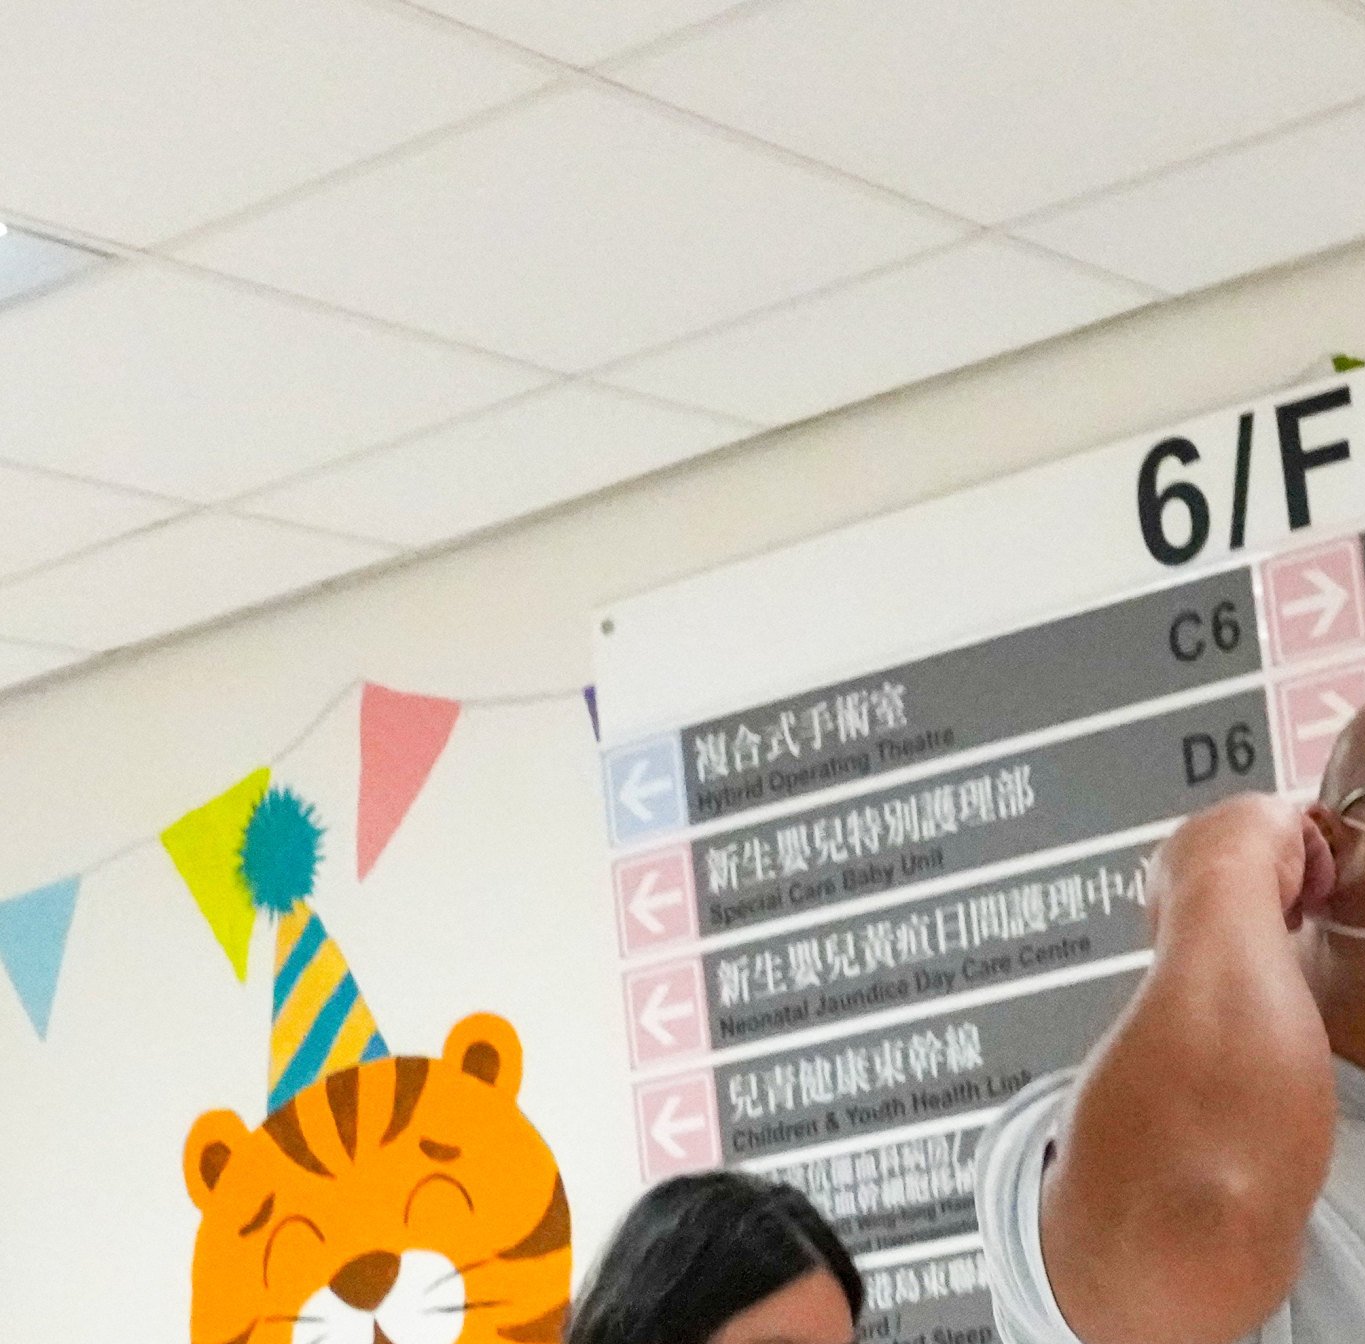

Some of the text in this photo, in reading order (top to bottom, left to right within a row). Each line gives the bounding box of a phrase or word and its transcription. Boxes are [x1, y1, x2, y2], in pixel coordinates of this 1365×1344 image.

[1137, 385, 1352, 566] 6/F
[1169, 602, 1240, 661] C6
[698, 727, 955, 812] Hybrid Operating Theatre
[1183, 722, 1255, 787] D6
[710, 848, 944, 925] Special Care Baby Unit
[719, 935, 1091, 1041] Neonatal Jaundice Day Care Centre
[732, 1116, 819, 1152] Children
[824, 1110, 840, 1133] &
[845, 1096, 906, 1129] Youth
[912, 1079, 980, 1113] Health
